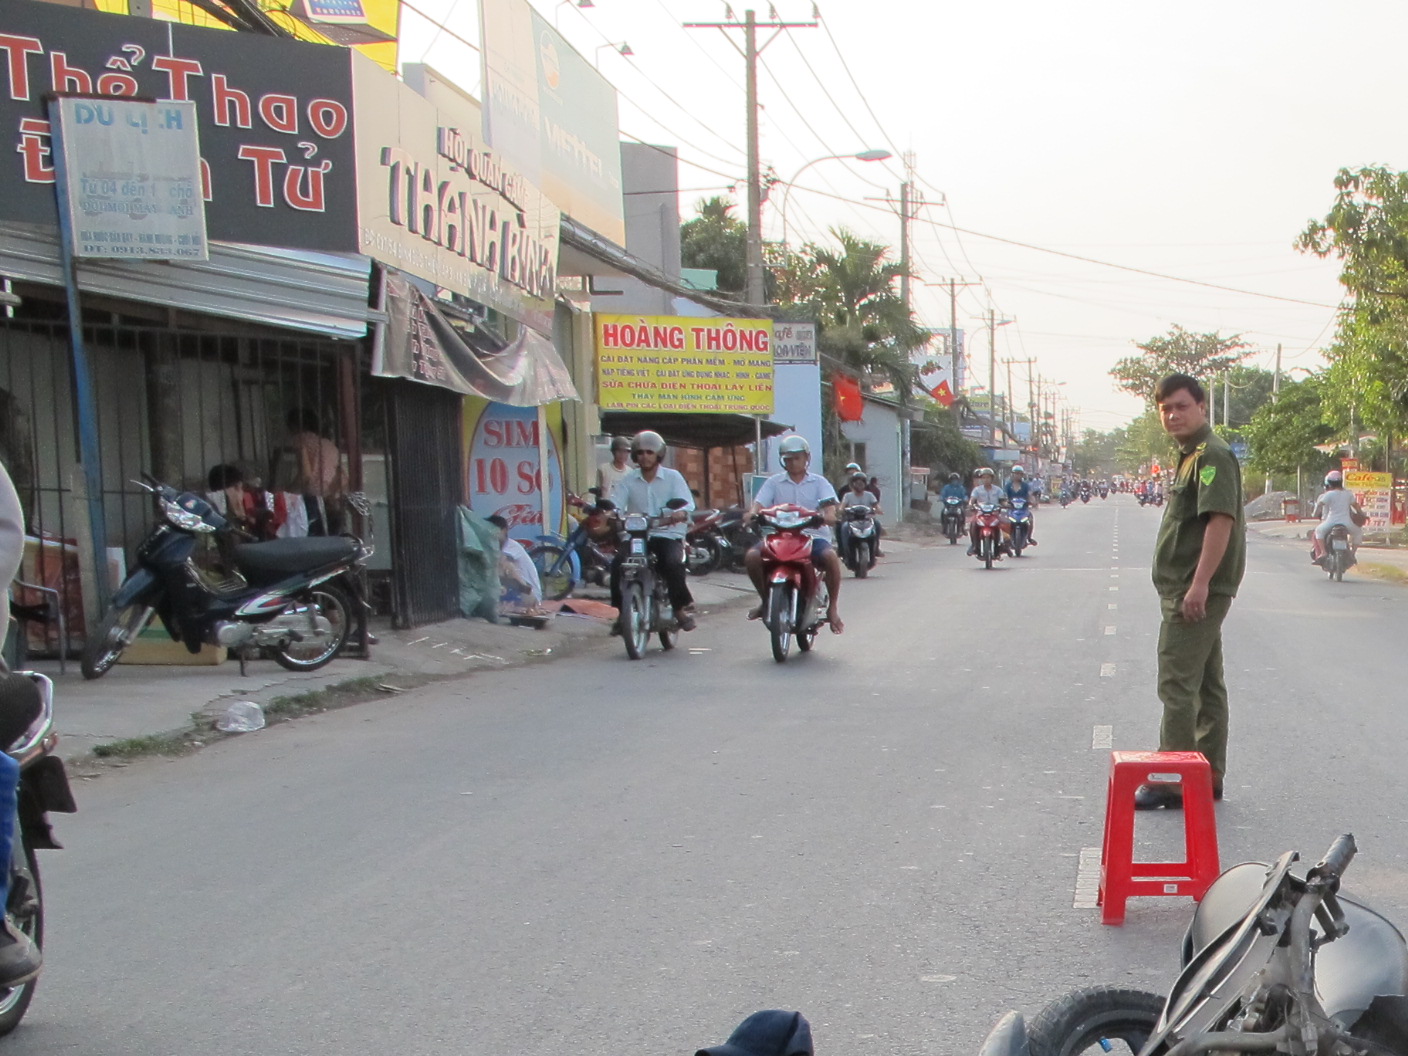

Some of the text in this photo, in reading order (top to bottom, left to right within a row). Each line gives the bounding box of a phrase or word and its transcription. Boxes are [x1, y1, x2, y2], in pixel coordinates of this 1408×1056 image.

[152, 56, 348, 139] Thao
[238, 142, 332, 212] Tử
[603, 319, 769, 352] HOÀNG THÔNG
[482, 419, 540, 448] SIM
[474, 457, 509, 495] 10
